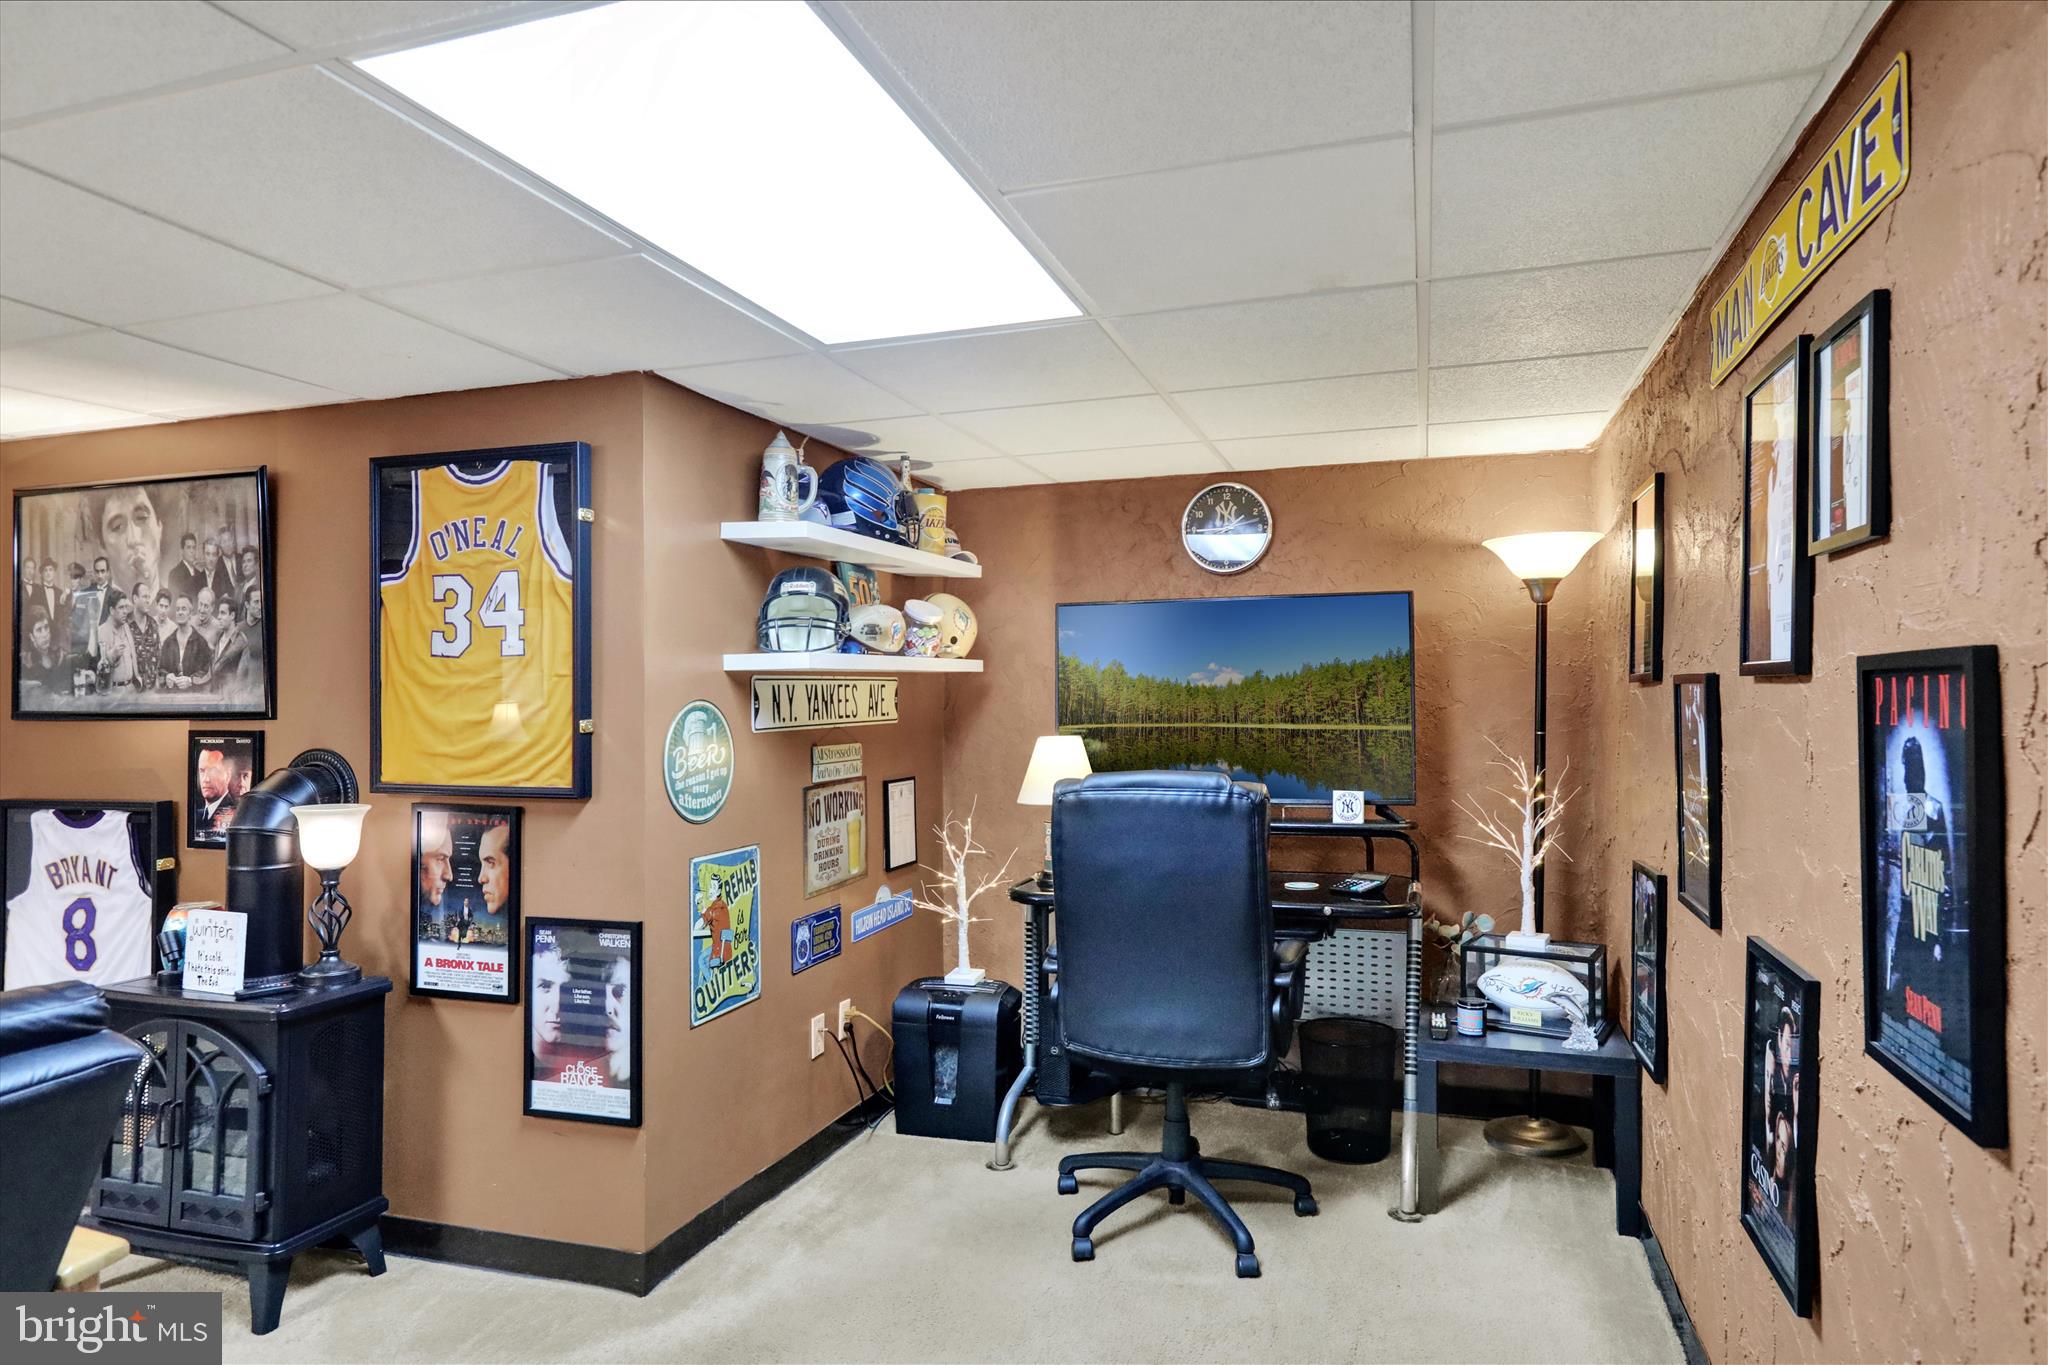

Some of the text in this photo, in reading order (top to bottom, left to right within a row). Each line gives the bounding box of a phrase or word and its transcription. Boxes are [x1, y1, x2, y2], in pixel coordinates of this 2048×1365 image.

[1715, 95, 1885, 370] MAN CAVE
[1195, 510, 1204, 519] 10
[1252, 507, 1259, 515] 2
[428, 515, 525, 561] O'NEAL
[430, 569, 526, 659] 34
[772, 683, 890, 724] N.Y. YANKEES AVE.
[692, 783, 709, 794] every
[678, 789, 722, 809] afternoon
[808, 790, 864, 829] NO WORKING
[816, 834, 841, 849] DURING
[814, 845, 844, 862] DRINKING
[45, 855, 119, 890] BRYANT
[818, 858, 840, 873] HOURS
[724, 858, 758, 907] REHAB
[736, 908, 745, 926] is
[62, 897, 97, 972] 8
[192, 921, 233, 939] winter
[535, 935, 556, 943] PENN
[598, 932, 631, 940] CHRISTOPHER
[733, 926, 749, 951] for
[599, 939, 631, 948] WALKEN
[424, 957, 504, 973] A BRONX TALE
[694, 941, 758, 1014] QUITTERS
[565, 1064, 598, 1076] CLOSE
[560, 1071, 604, 1088] RANGE
[1750, 1152, 1780, 1208] CASINO
